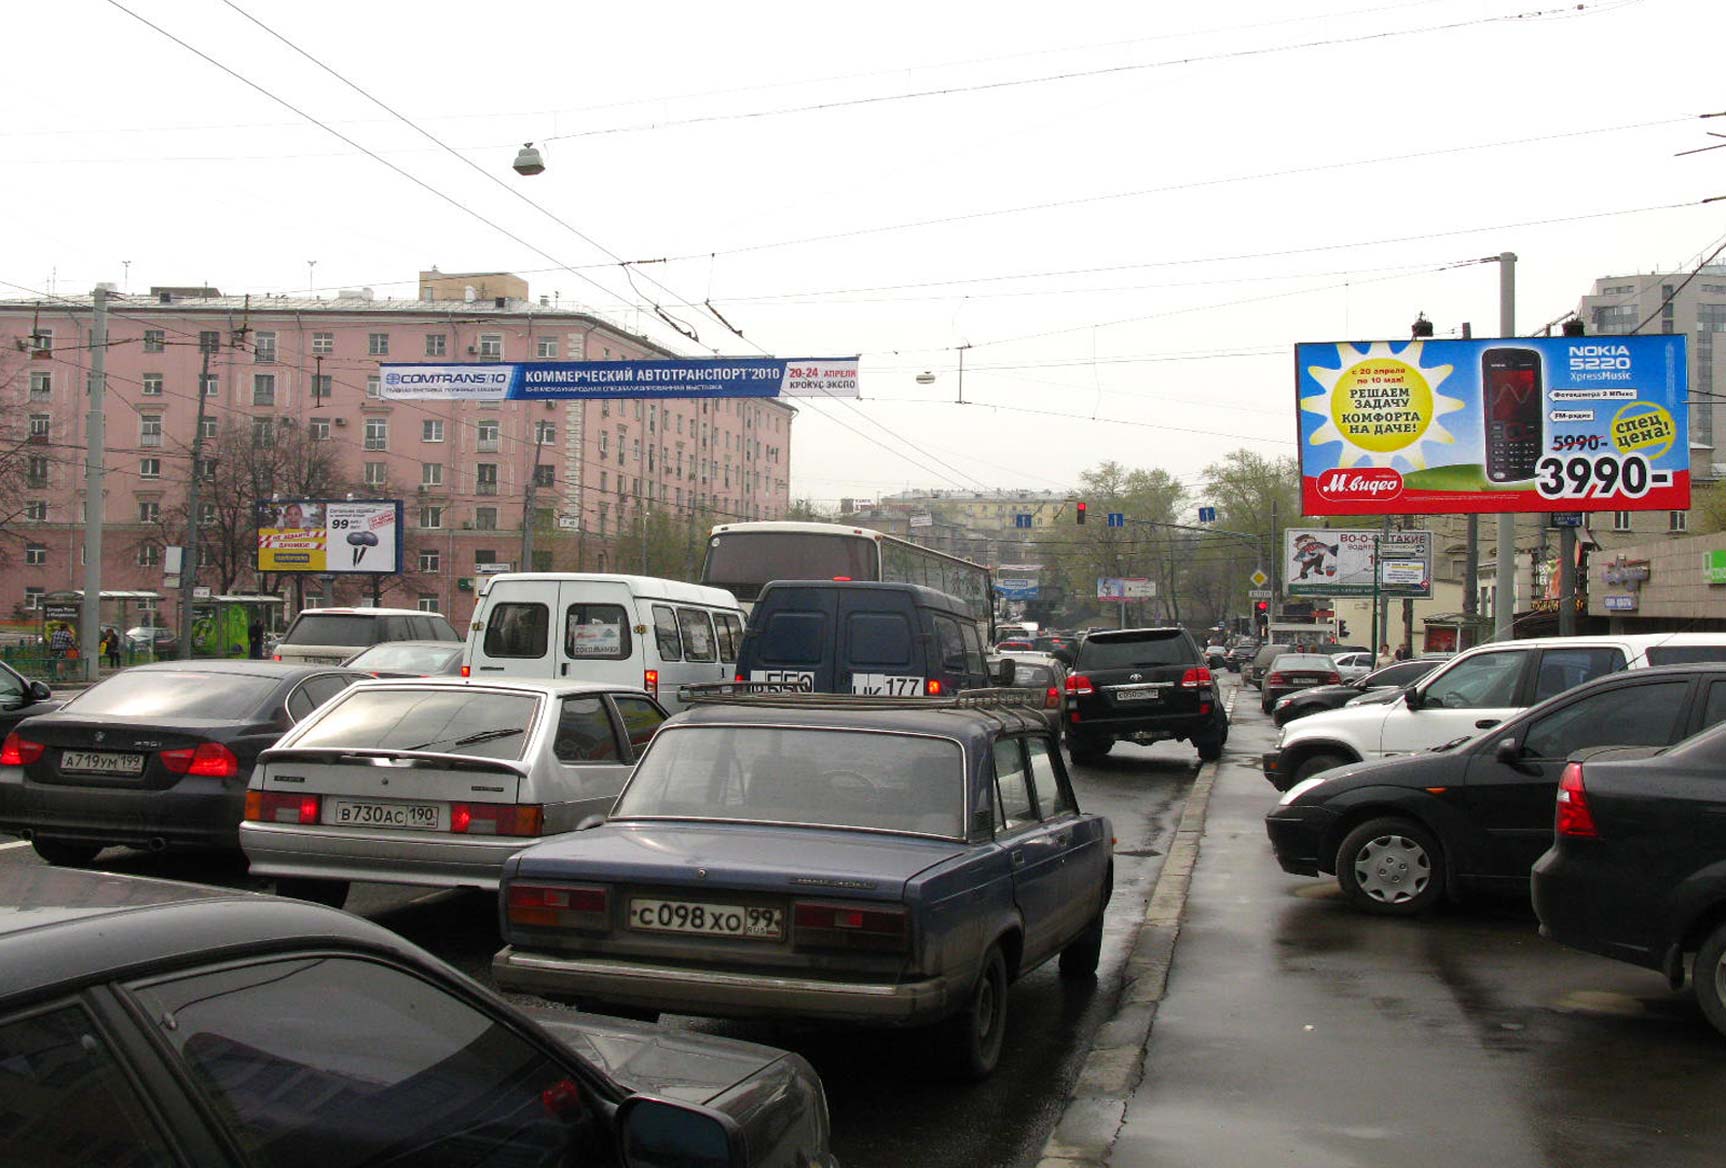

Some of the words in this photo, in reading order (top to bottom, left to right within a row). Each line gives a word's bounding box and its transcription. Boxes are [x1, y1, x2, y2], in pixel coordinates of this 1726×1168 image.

[1569, 345, 1631, 357] NOKIA
[1569, 357, 1631, 371] 5220
[525, 367, 633, 382] КОММЕРЧЕСКИЙ
[789, 367, 819, 378] 20-24
[823, 369, 857, 378] АПРЕЛЯ
[1570, 371, 1632, 383] XpressMusic
[789, 380, 824, 389] КРОКУС
[826, 380, 856, 389] ЭКСПО
[1350, 388, 1410, 399] РЕШАЕМ
[1355, 399, 1410, 410] ЗАДАЧУ
[1341, 411, 1421, 424] КОМФОРТА
[1615, 412, 1662, 434] спец
[1349, 425, 1370, 434] НА
[1373, 423, 1417, 435] ДАЧЕ!
[1616, 422, 1671, 448] цена!
[331, 519, 349, 530] 99
[1390, 534, 1425, 545] ТАКИЕ
